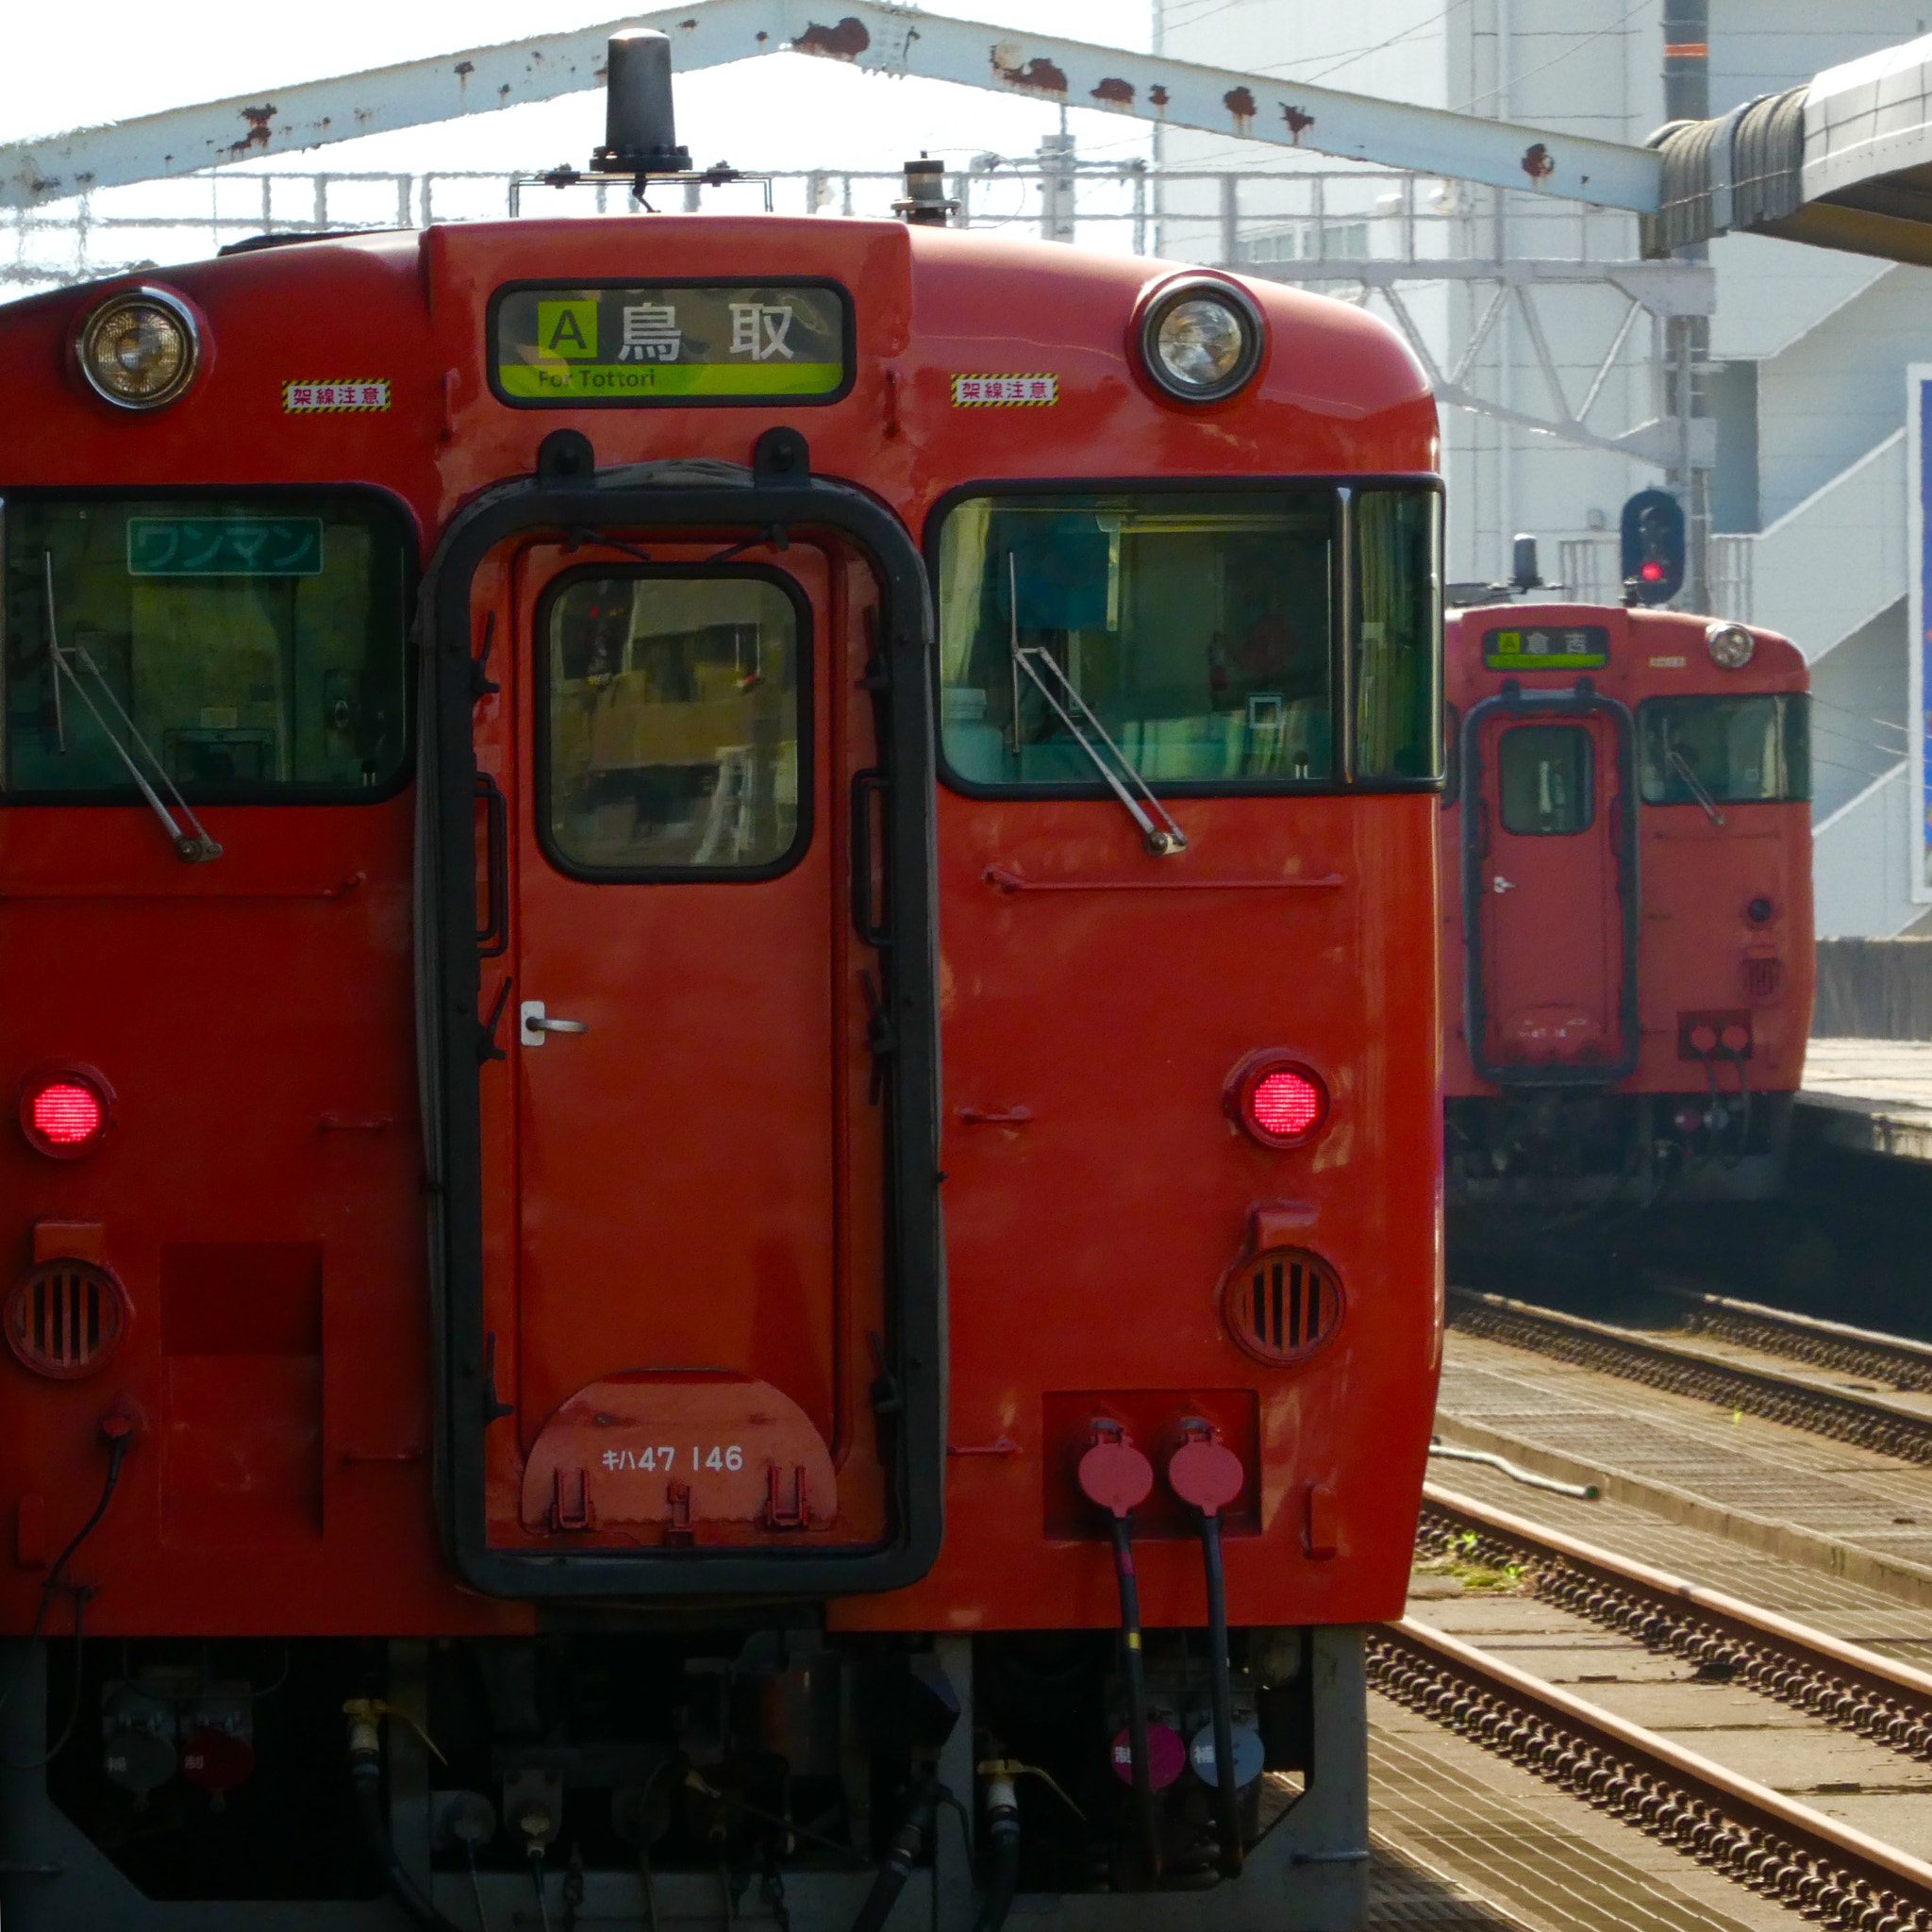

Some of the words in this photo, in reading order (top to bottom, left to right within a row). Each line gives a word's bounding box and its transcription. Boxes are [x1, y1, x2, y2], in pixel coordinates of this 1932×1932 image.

[548, 309, 587, 350] A
[617, 302, 795, 361] 鳥取
[539, 369, 571, 388] For
[581, 368, 656, 388] Tottori
[962, 380, 1048, 400] 架線注意
[293, 386, 379, 406] 架線注意
[138, 525, 314, 568] ワンマン
[602, 1446, 675, 1472] キハ47
[692, 1445, 743, 1472] 146
